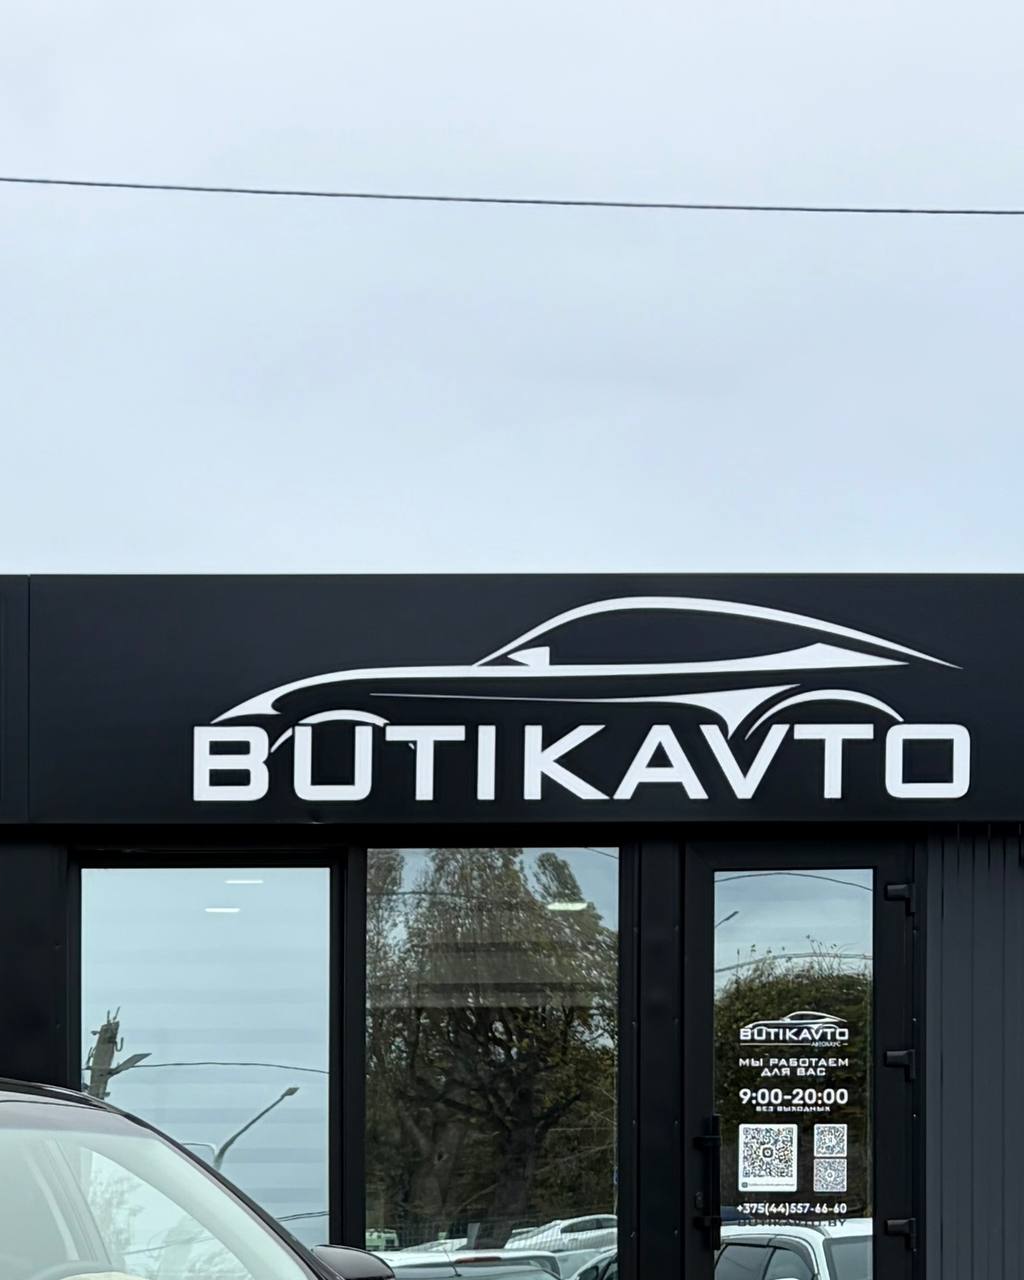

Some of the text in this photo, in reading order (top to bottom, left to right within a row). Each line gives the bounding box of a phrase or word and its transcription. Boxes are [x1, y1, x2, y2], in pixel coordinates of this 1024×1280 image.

[193, 723, 971, 801] BUTIKAVTO
[739, 1028, 849, 1040] BUTIKAVTO
[739, 1058, 849, 1067] МЫ РАБОТАЕМ
[761, 1068, 826, 1077] ДЛЯ ВАС
[739, 1088, 848, 1105] 9:00-20:00
[736, 1203, 847, 1216] +375(44)557-66-60
